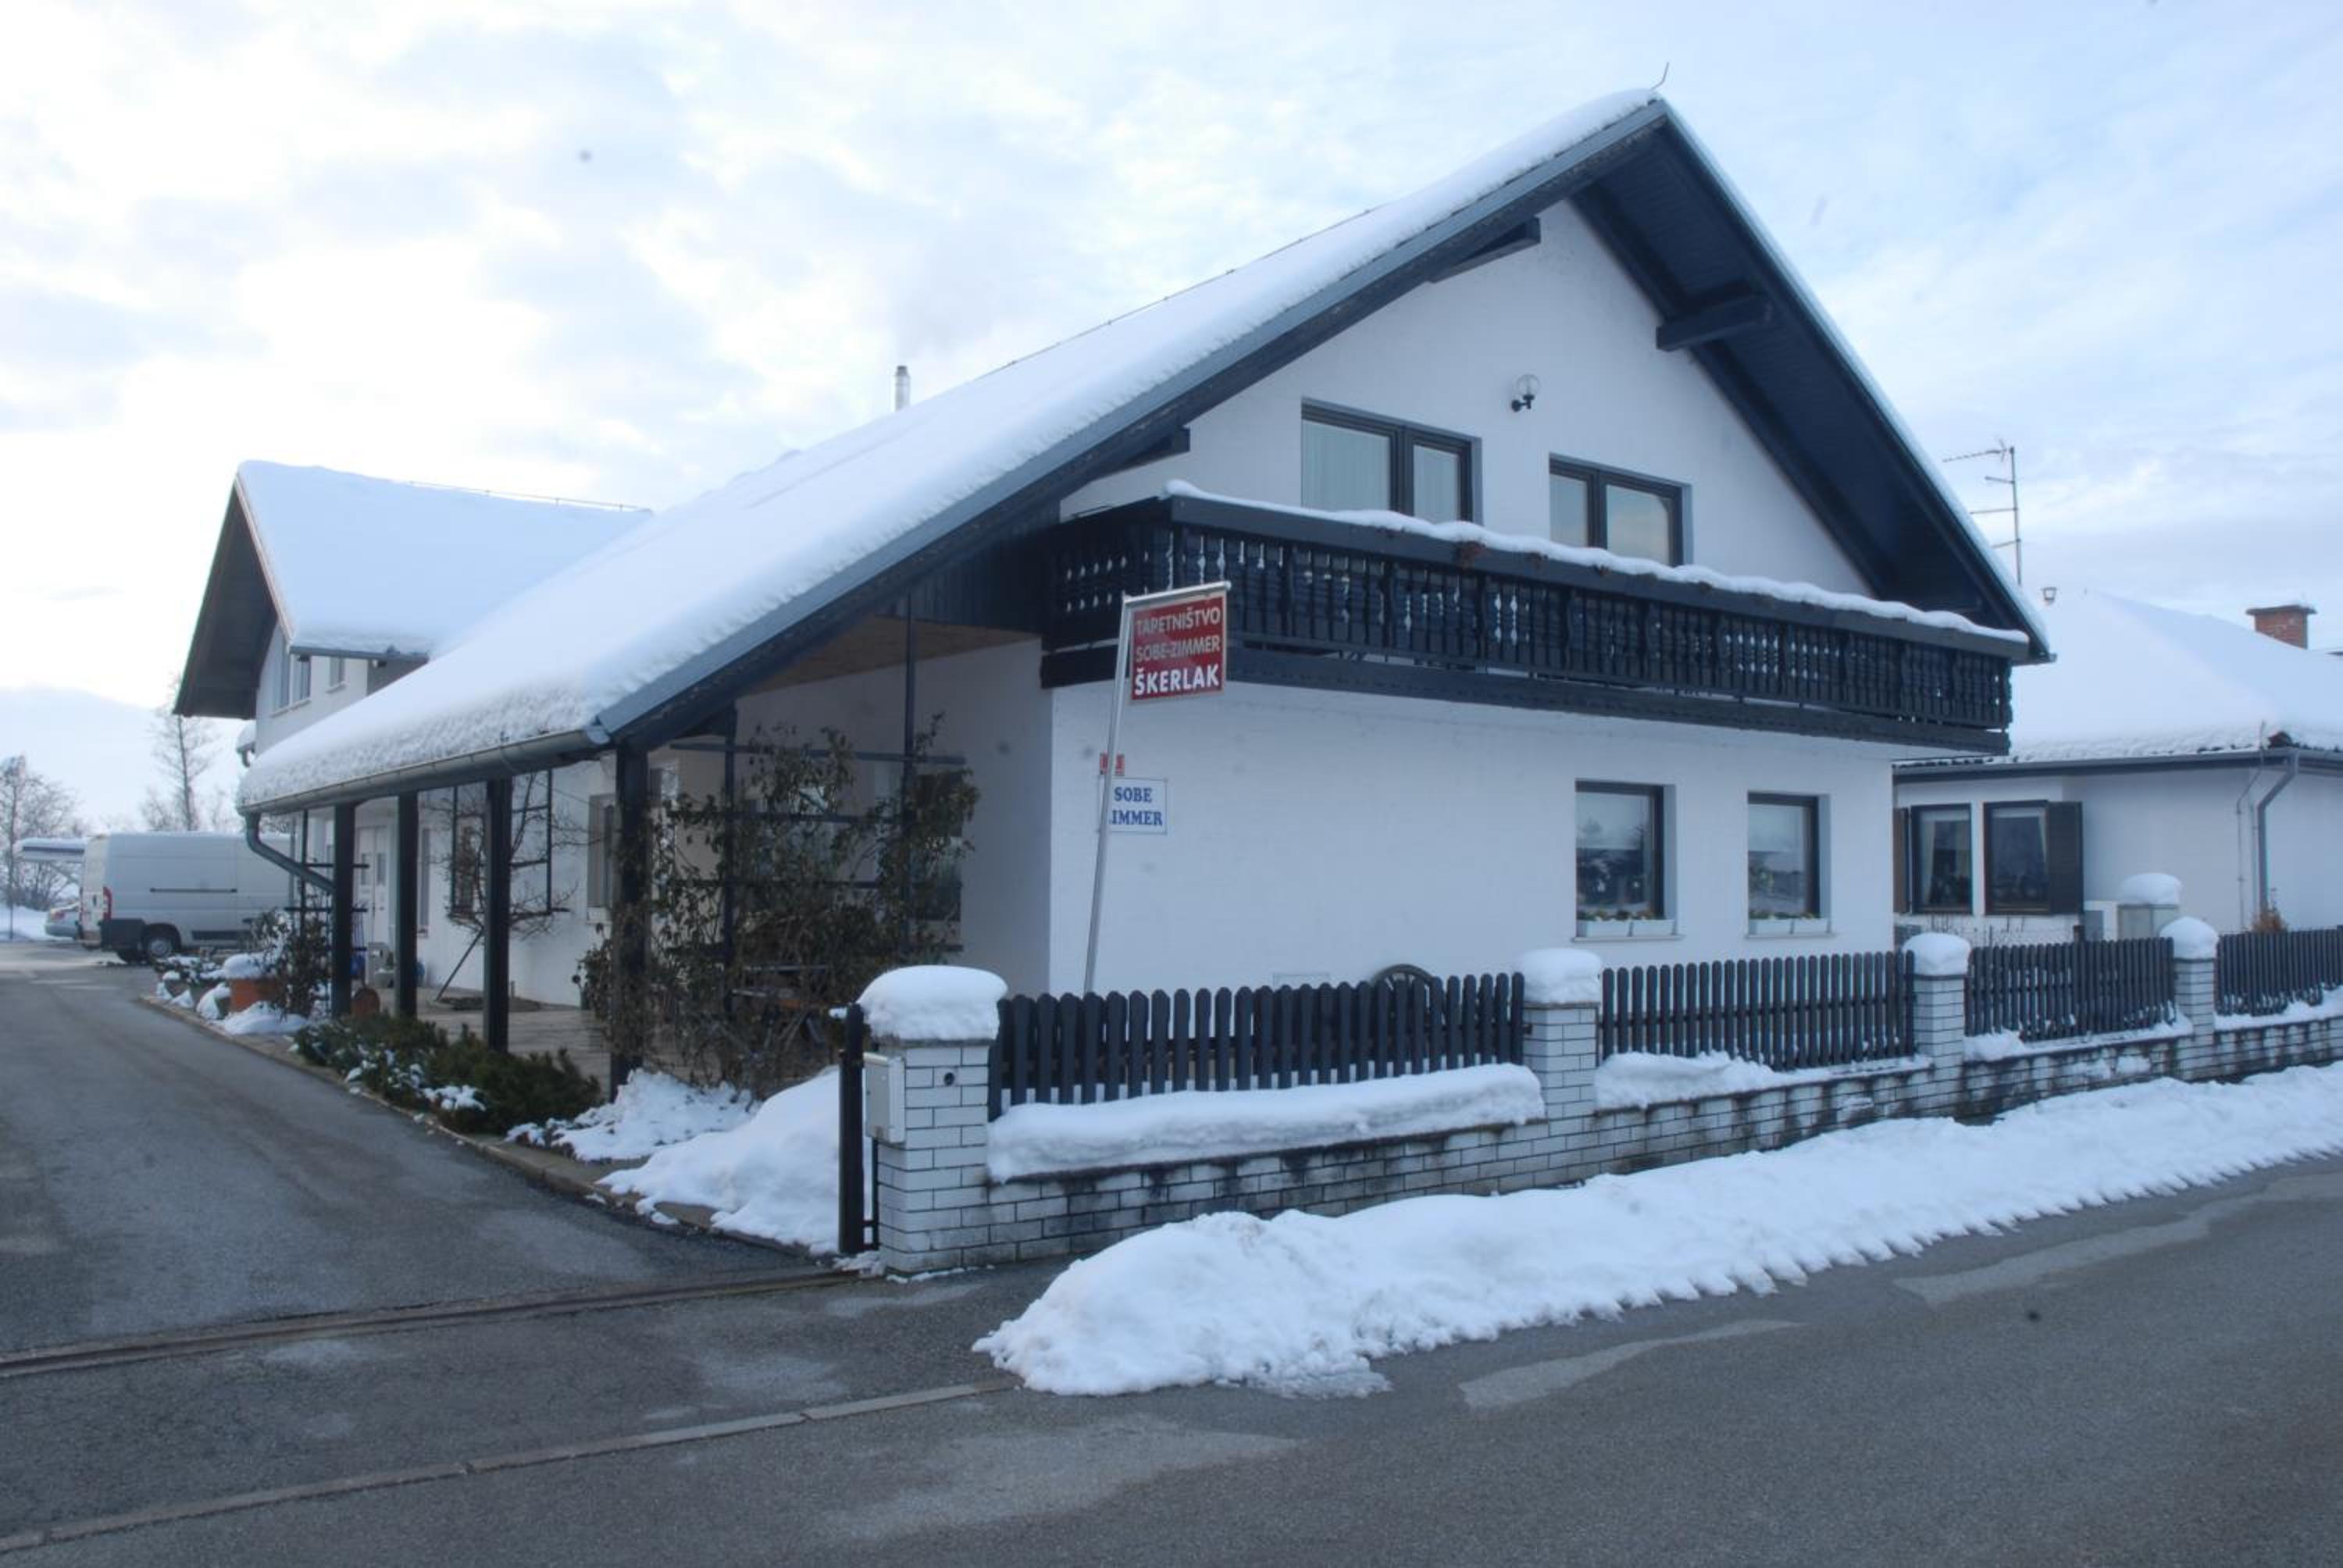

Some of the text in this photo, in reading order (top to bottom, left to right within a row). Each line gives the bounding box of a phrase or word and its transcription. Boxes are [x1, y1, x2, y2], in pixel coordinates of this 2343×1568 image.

[1136, 607, 1221, 636] TAPETNIŠTVO
[1135, 664, 1219, 696] ŠKERLAK
[1114, 786, 1153, 803] SOBE
[1109, 810, 1163, 826] IMMER
